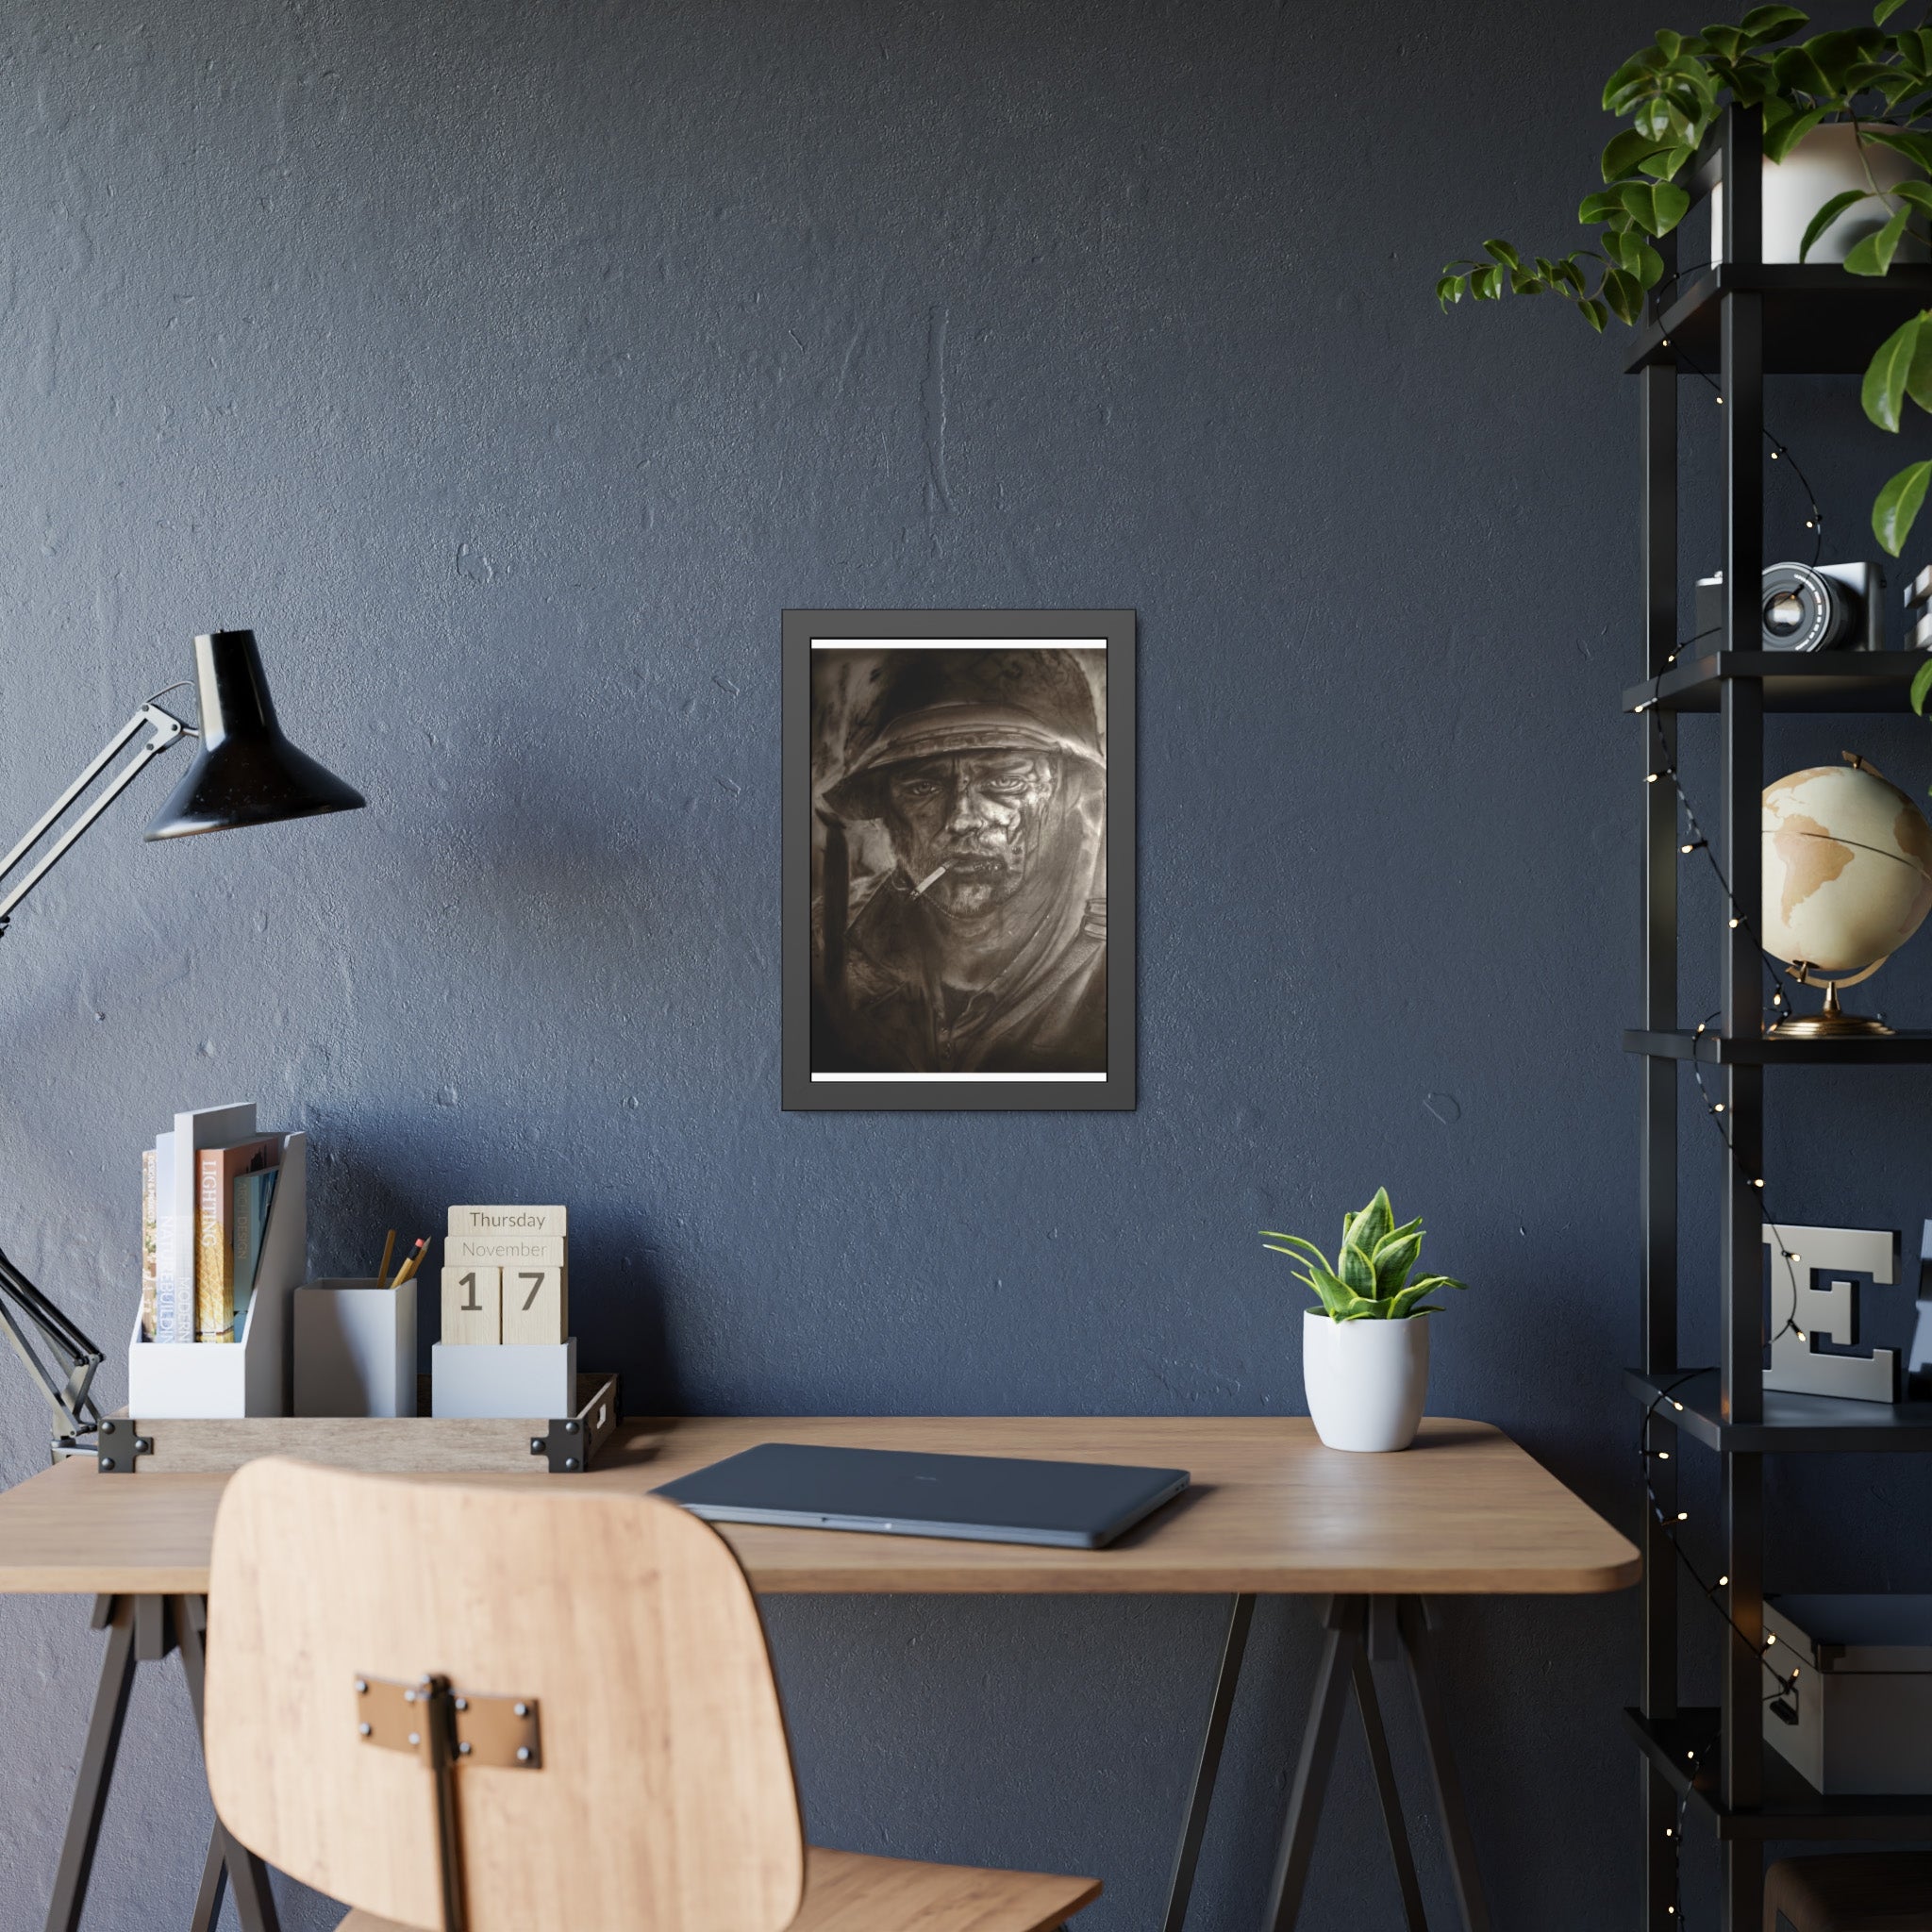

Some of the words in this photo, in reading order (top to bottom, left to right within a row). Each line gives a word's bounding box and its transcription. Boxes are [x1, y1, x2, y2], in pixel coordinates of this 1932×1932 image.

[202, 1160, 217, 1246] LIGHTING
[470, 1212, 545, 1230] Thursday
[237, 1216, 248, 1259] DESIGN
[462, 1241, 547, 1257] November
[177, 1276, 192, 1341] MODERN
